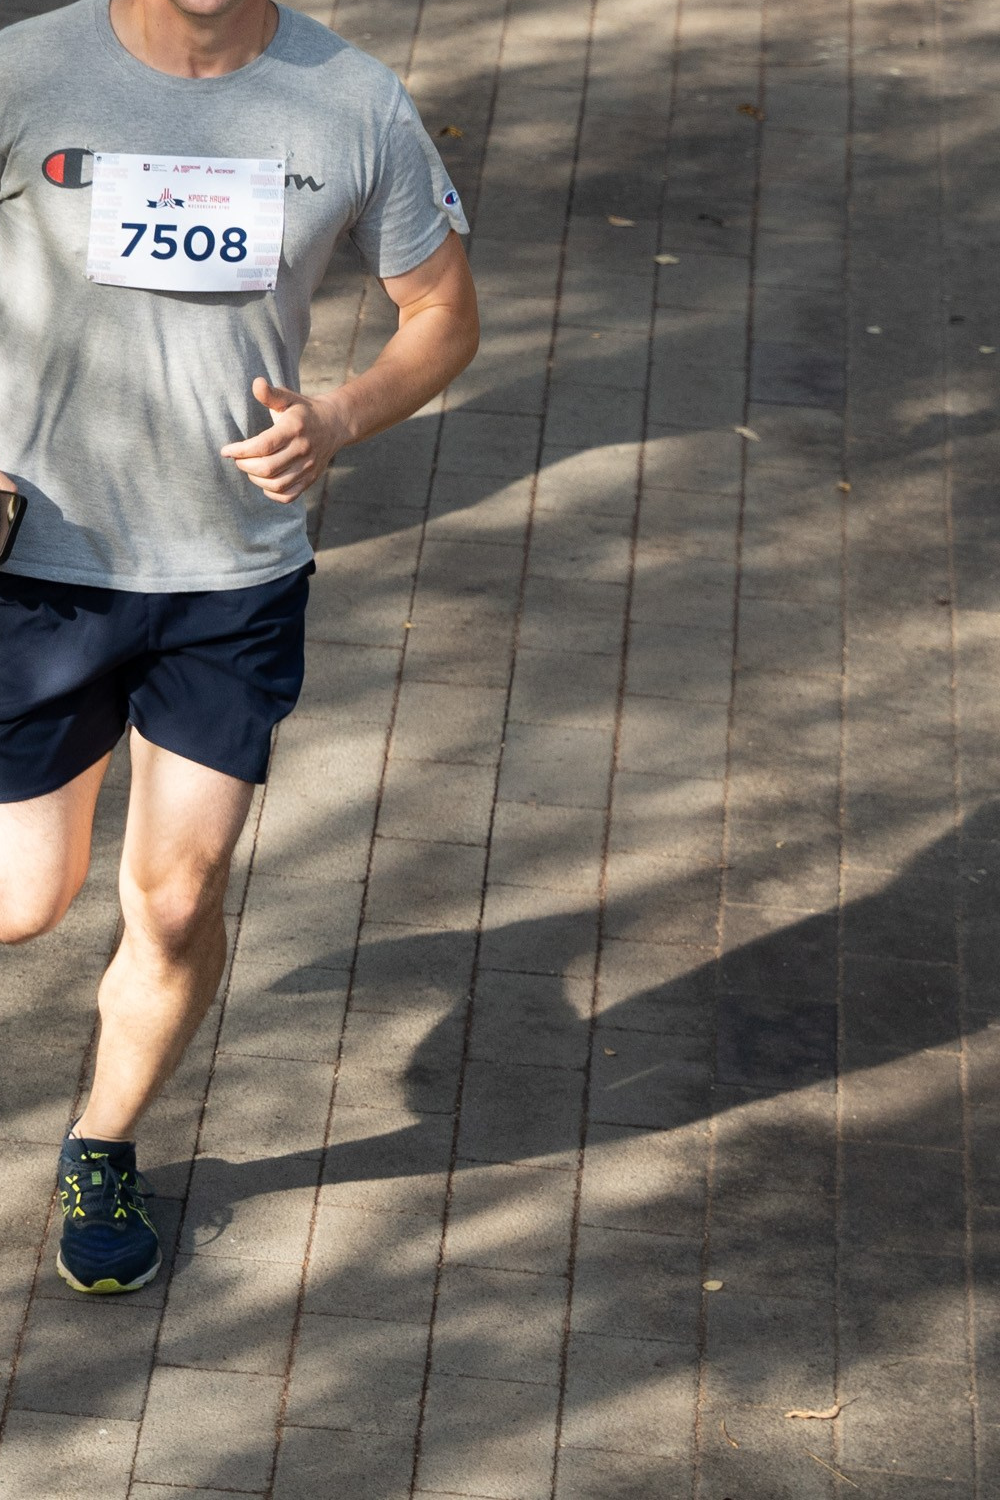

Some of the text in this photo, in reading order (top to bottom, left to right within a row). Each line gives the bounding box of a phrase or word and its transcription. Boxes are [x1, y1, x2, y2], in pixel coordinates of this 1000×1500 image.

[188, 194, 230, 204] КРОСС НАЦИИ
[120, 222, 247, 263] 7508
